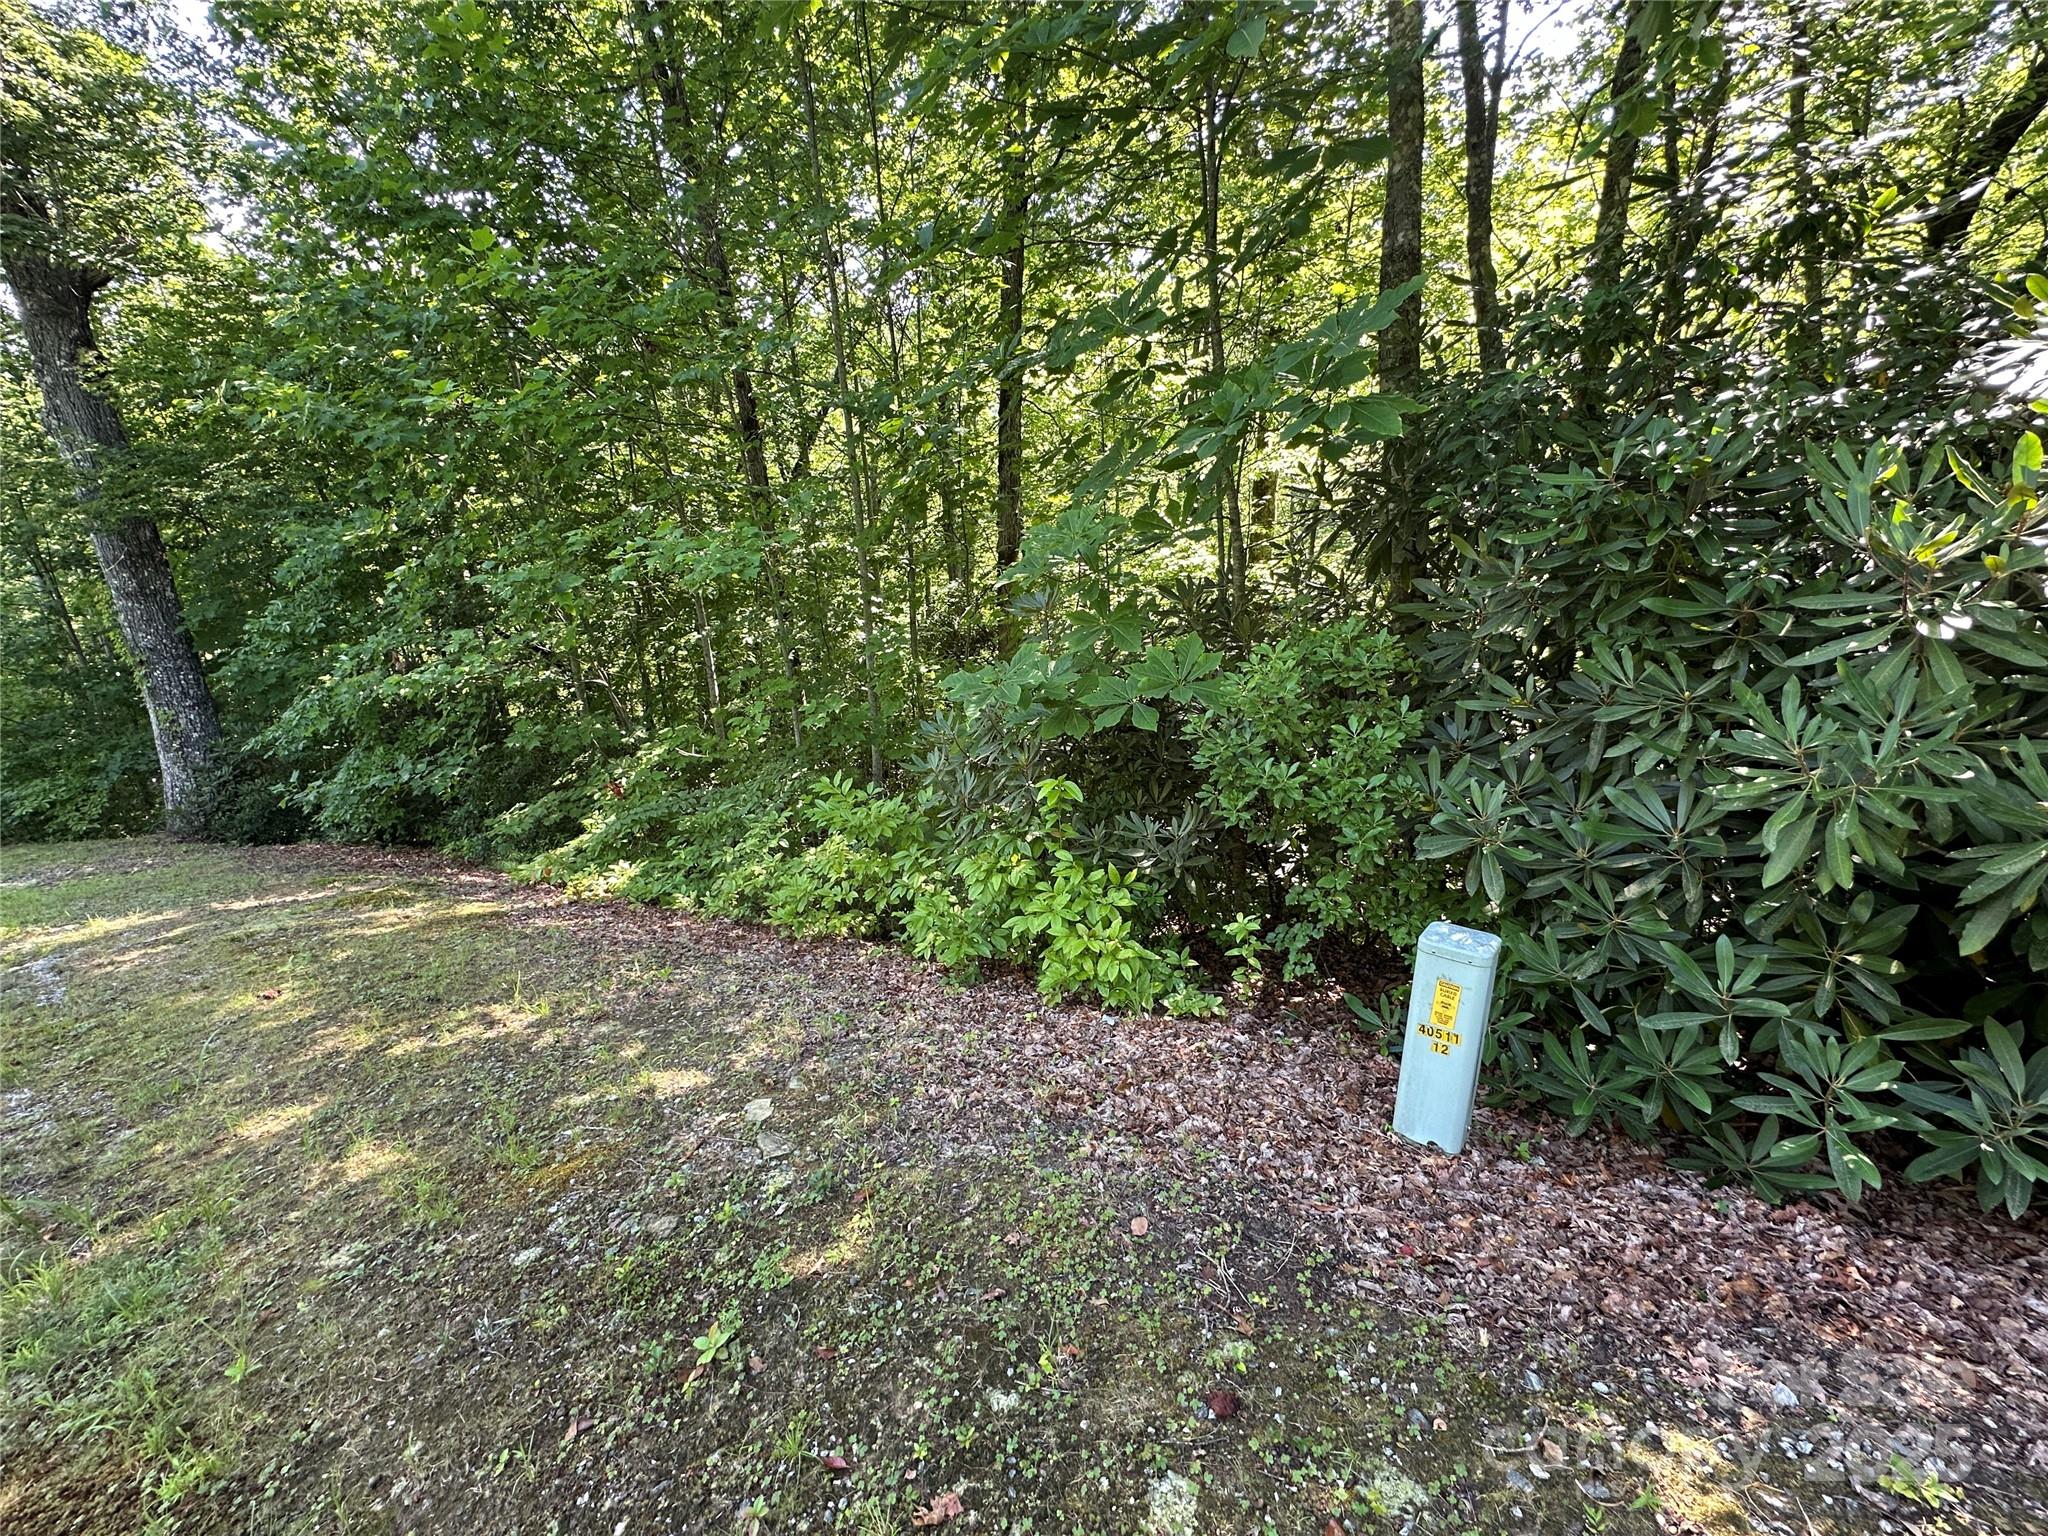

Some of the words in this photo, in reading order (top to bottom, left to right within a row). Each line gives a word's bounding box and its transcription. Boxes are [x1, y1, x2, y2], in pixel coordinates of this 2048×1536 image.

[1440, 992, 1455, 1001] CABLE
[1418, 1024, 1459, 1044] 40511
[1433, 1042, 1449, 1055] 12
